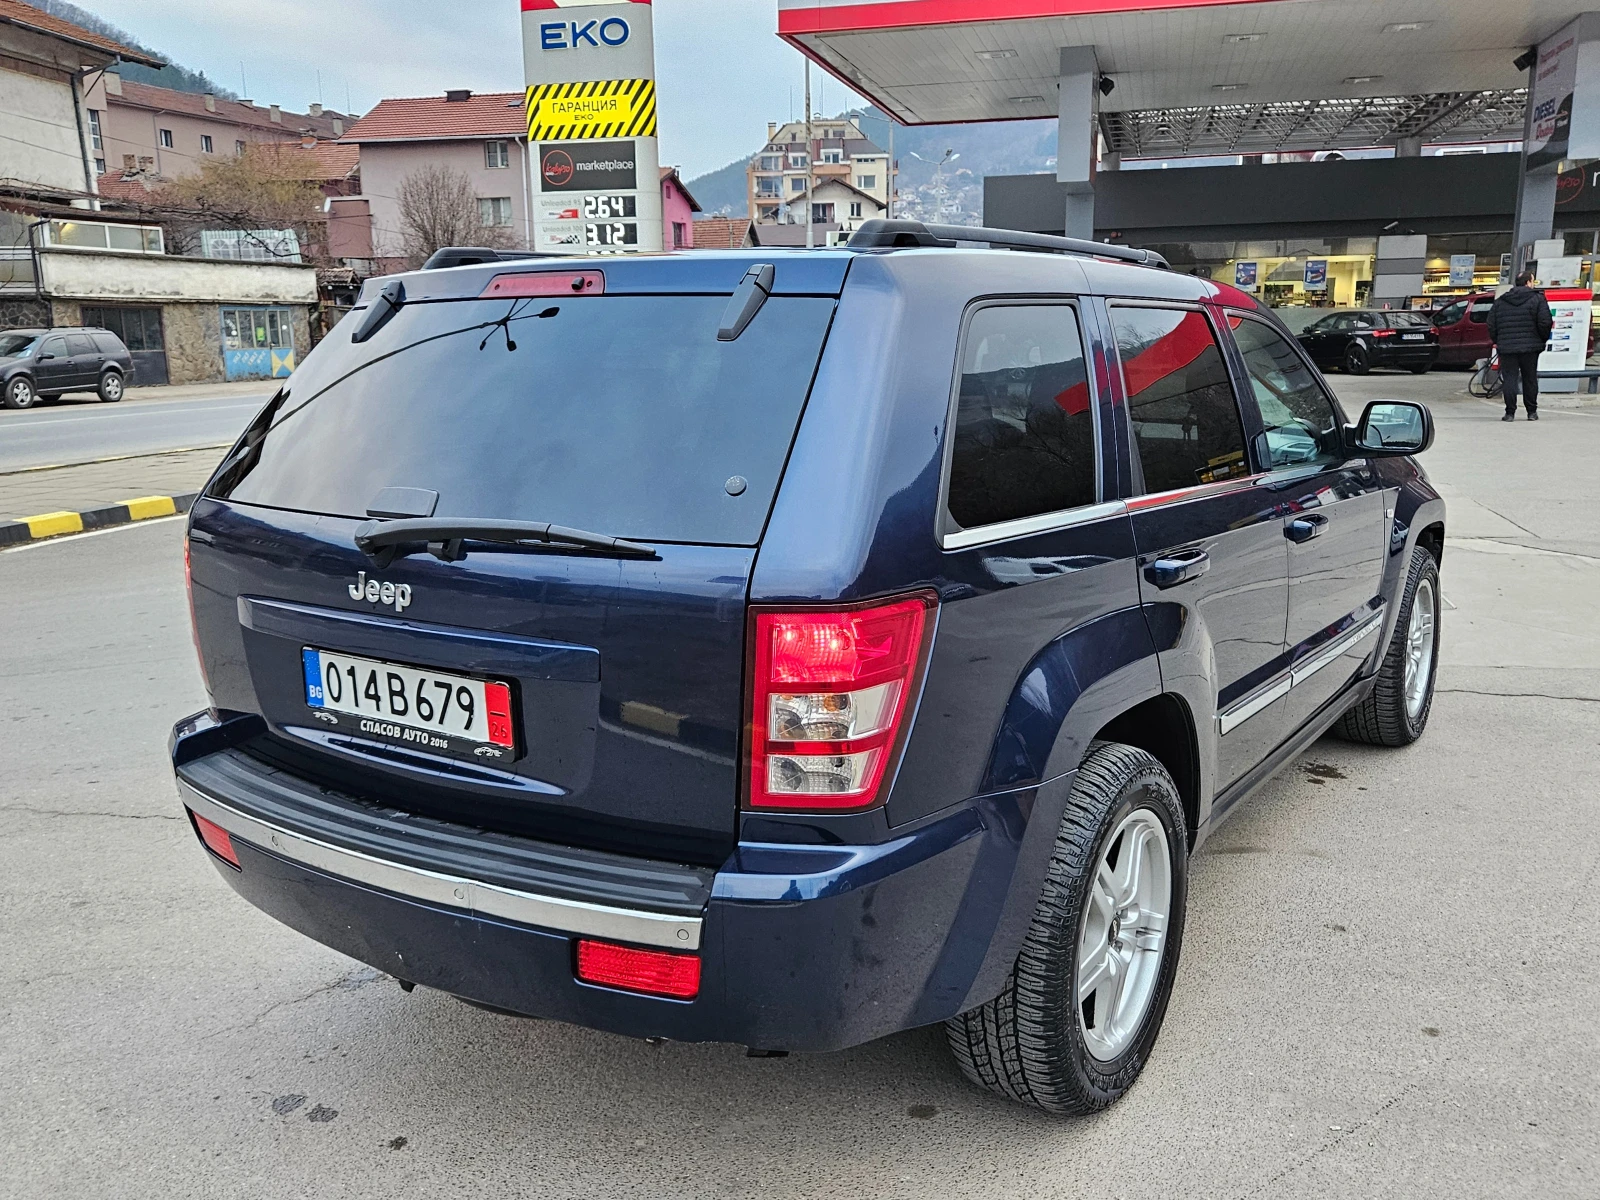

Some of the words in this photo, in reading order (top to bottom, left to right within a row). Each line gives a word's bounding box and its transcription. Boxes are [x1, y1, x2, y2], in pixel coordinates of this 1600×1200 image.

[540, 17, 630, 50] EKO
[552, 99, 617, 115] ГАРАНЦИЯ
[576, 159, 634, 172] marketplace
[584, 195, 624, 218] 2.64
[587, 222, 625, 246] 3.12
[348, 571, 412, 612] Jeep
[308, 684, 323, 699] BG
[360, 719, 401, 738] СПАСОВ
[429, 736, 448, 749] 2016
